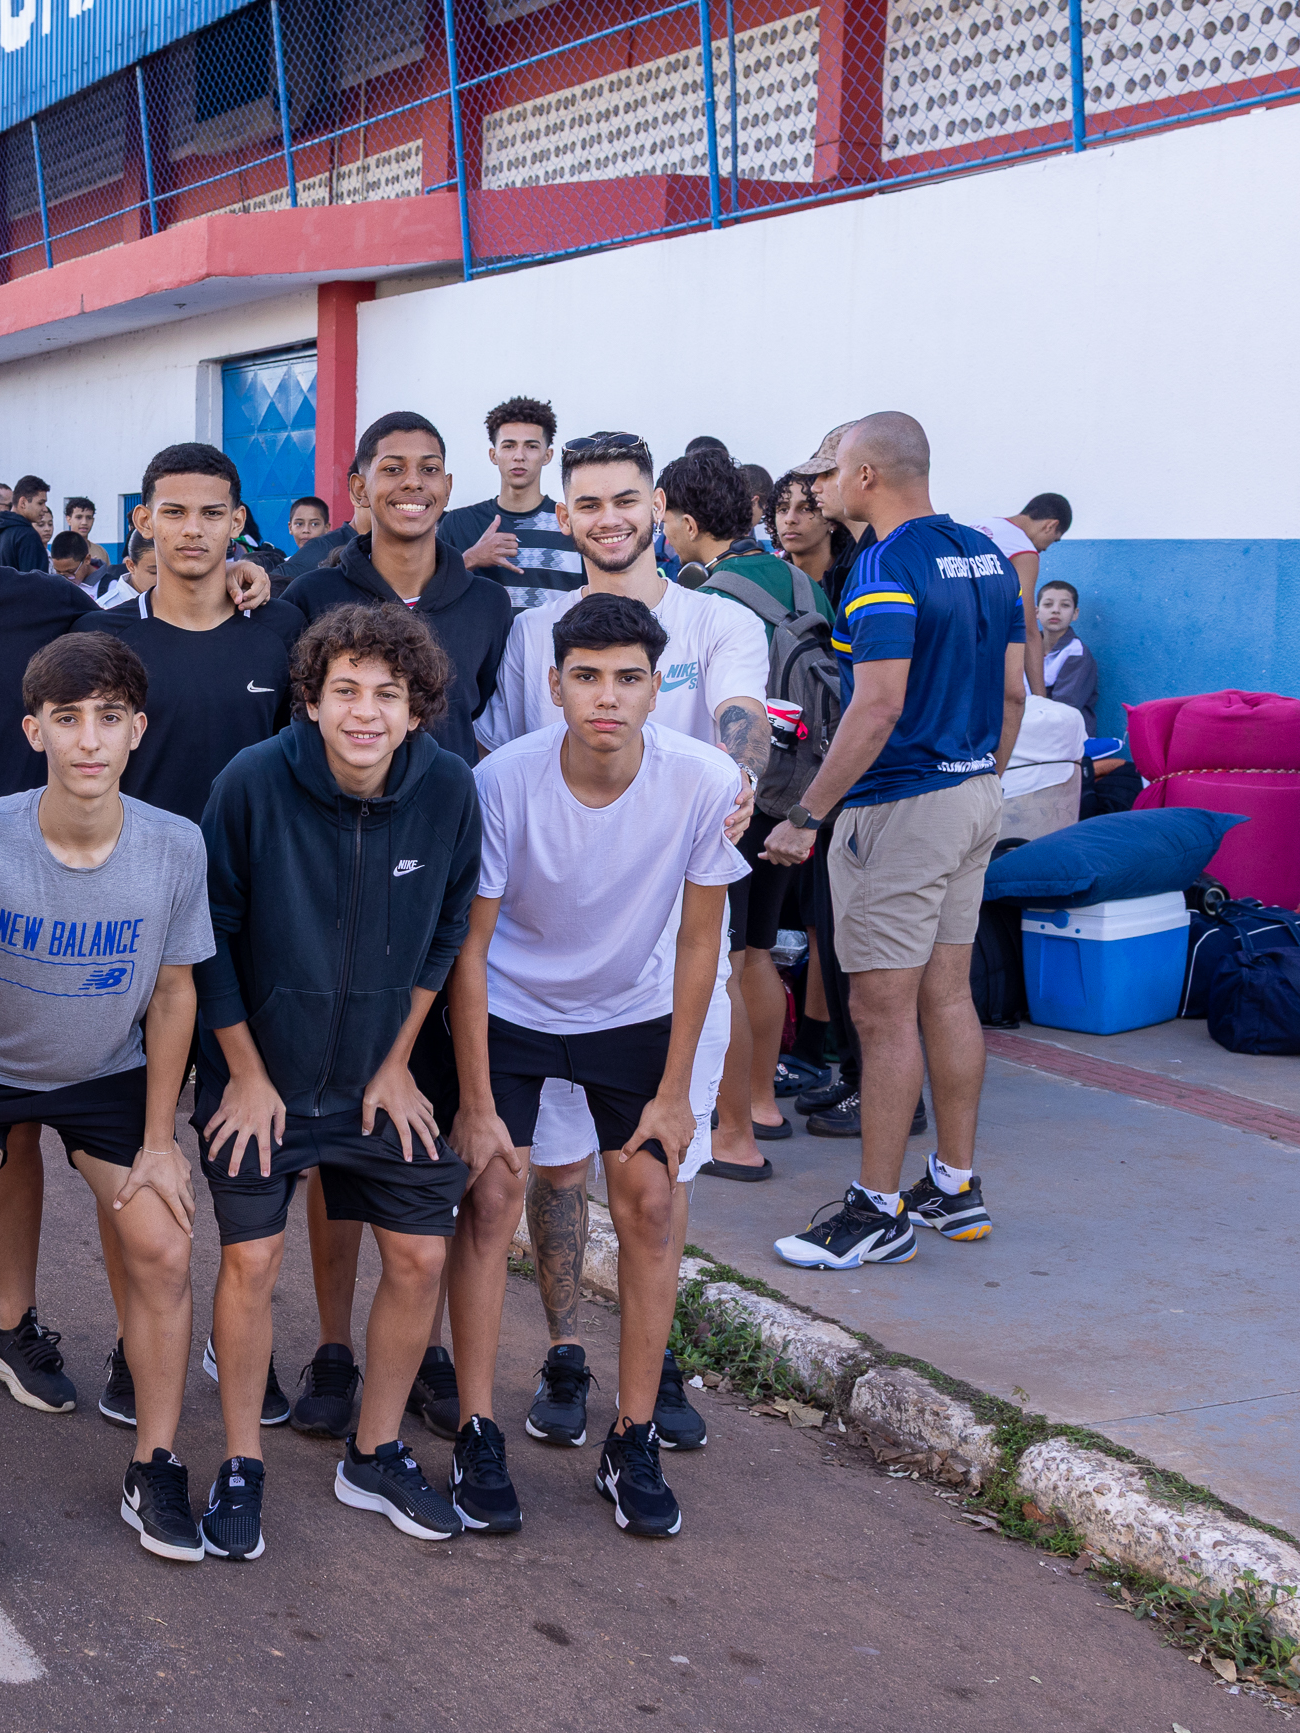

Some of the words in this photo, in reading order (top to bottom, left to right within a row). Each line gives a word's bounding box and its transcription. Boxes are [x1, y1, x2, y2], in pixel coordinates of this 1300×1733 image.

[666, 661, 698, 679] NIKE
[688, 677, 698, 690] S
[398, 860, 419, 870] NIKE
[48, 918, 144, 957] BALANCE
